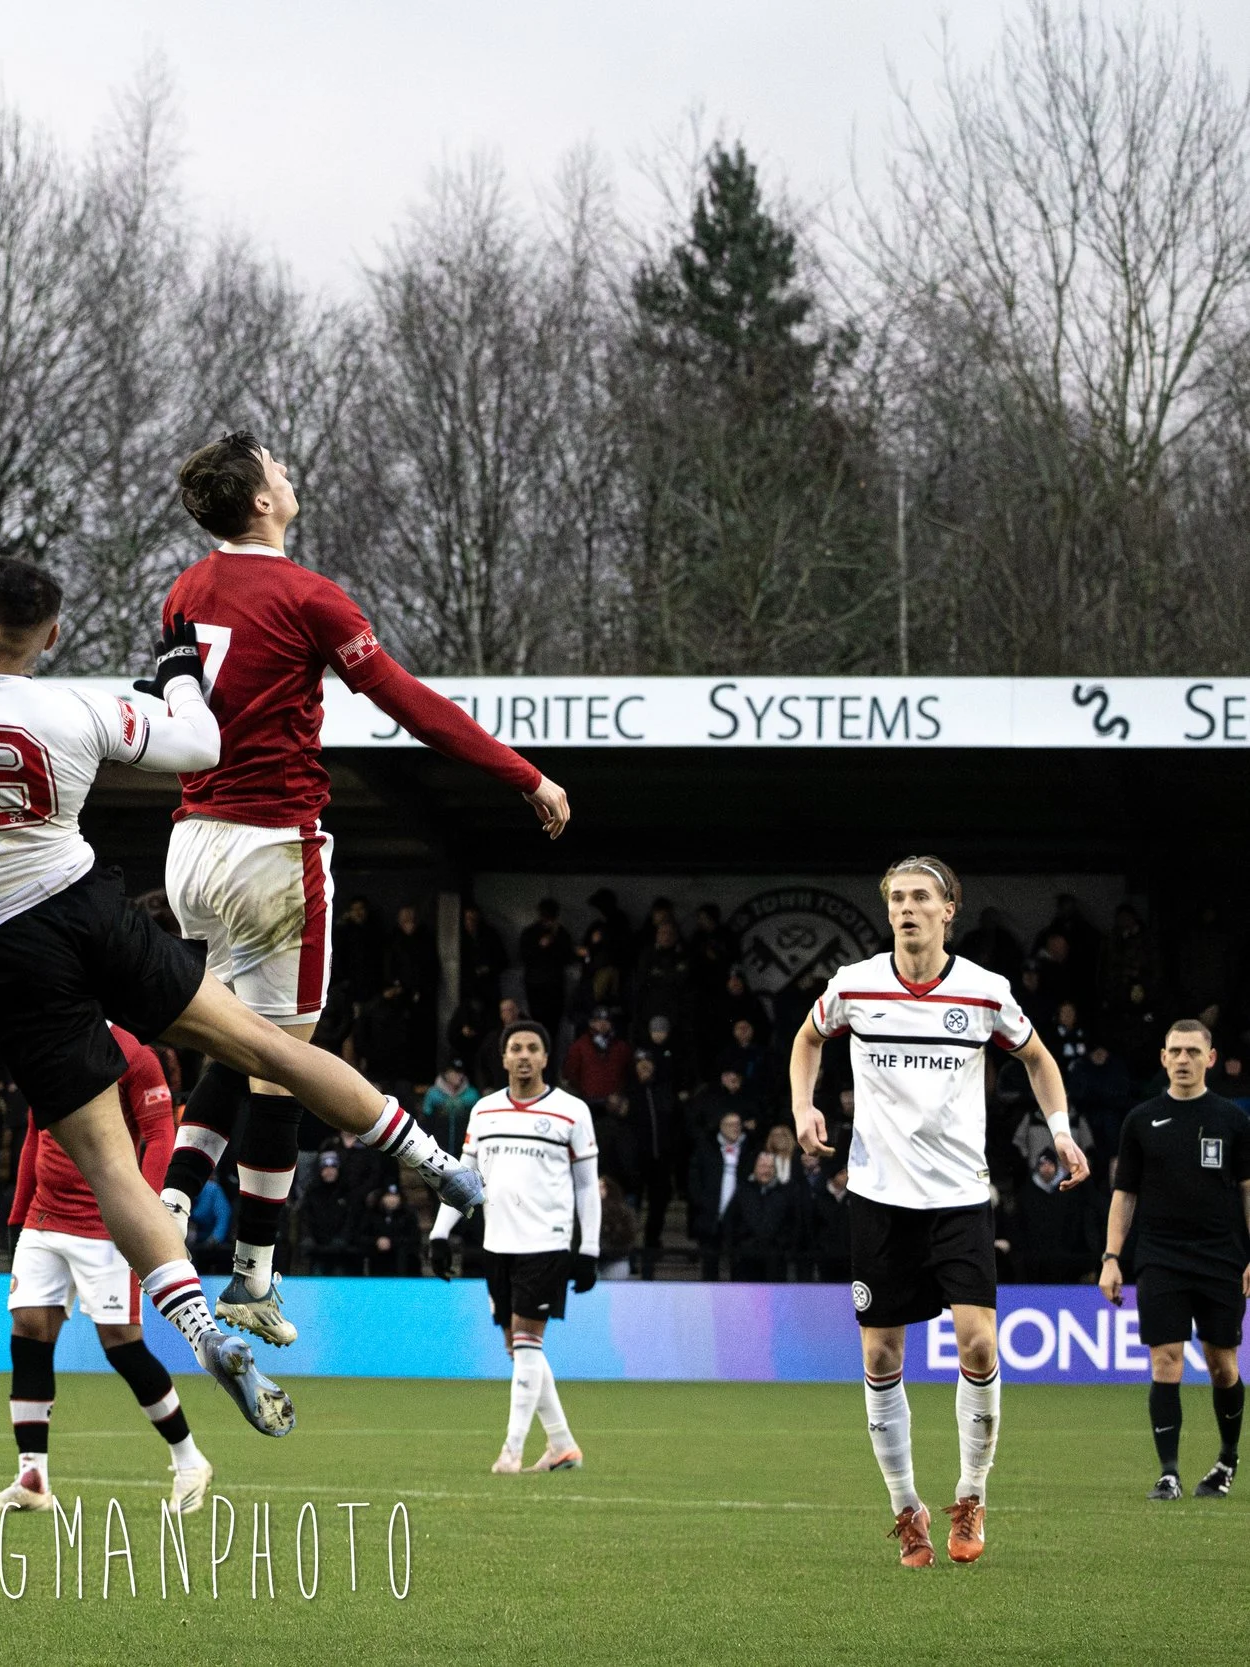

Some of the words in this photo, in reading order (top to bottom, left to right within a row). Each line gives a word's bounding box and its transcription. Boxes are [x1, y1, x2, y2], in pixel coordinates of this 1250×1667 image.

[184, 622, 232, 707] 7
[371, 694, 645, 740] URITEC
[707, 683, 942, 740] SYSTEMS
[868, 1053, 897, 1068] THE
[904, 1055, 966, 1071] PITMEN
[504, 1146, 545, 1159] PITMEN
[927, 1307, 1212, 1371] EONE
